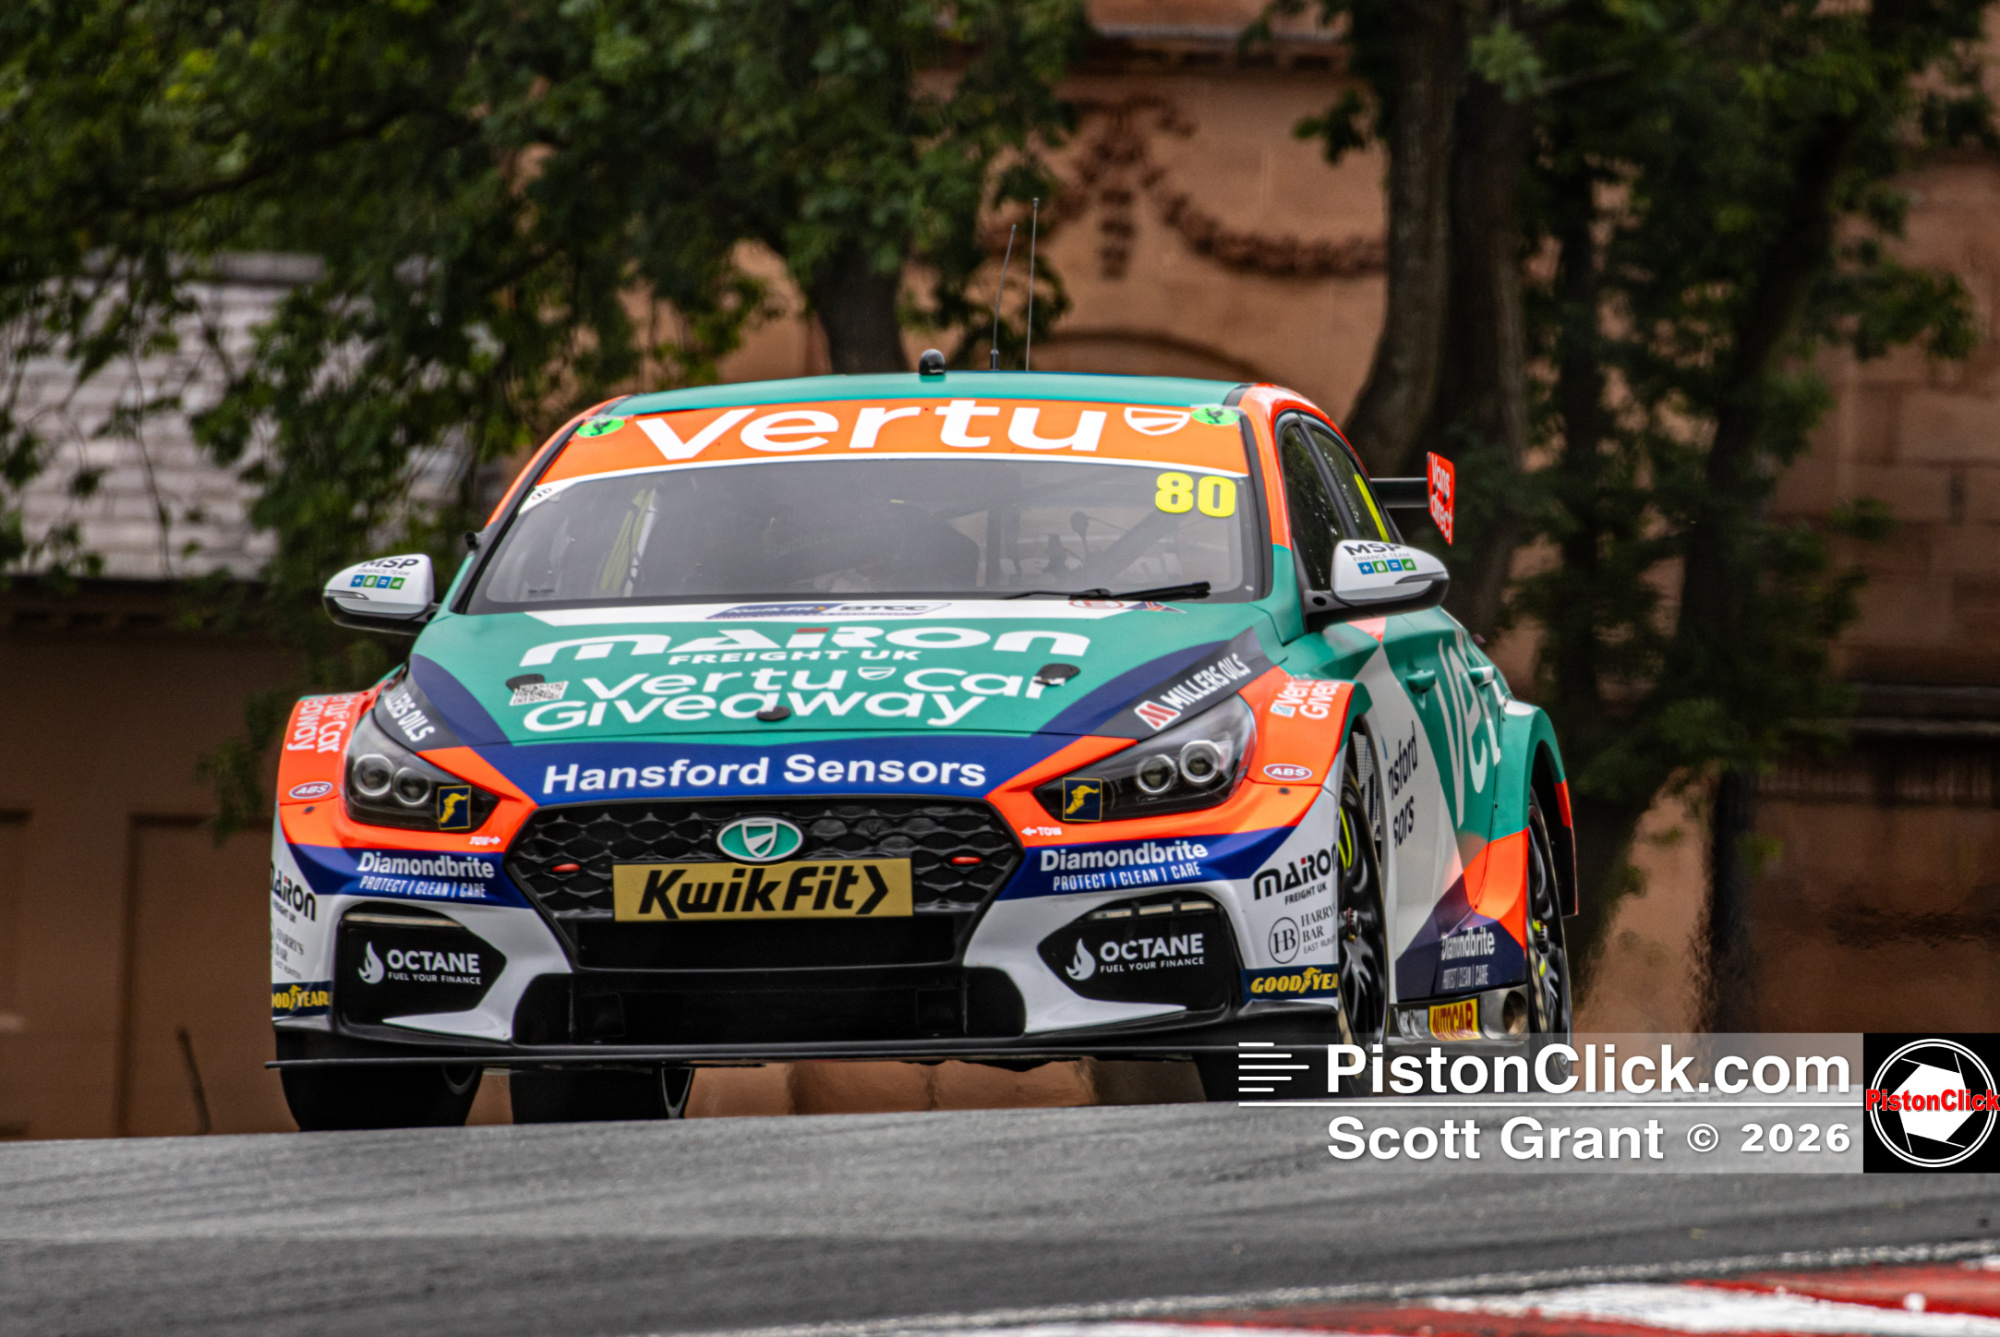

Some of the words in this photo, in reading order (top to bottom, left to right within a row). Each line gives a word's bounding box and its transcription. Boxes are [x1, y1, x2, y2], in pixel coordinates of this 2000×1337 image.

[635, 400, 1107, 461] Vertu
[1155, 471, 1237, 518] 80
[668, 650, 849, 666] FREIGHT
[858, 650, 922, 662] UK
[582, 667, 848, 700] Vertu
[903, 663, 1067, 699] Car
[1160, 665, 1230, 710] MILLERS
[1217, 653, 1251, 680] OILS
[398, 709, 435, 742] OILS
[523, 690, 988, 732] Giveaway
[317, 720, 348, 754] Car
[543, 756, 769, 795] Hansford
[783, 753, 987, 787] Sensors
[1273, 766, 1306, 778] ABS
[1387, 719, 1418, 801] nsford
[295, 784, 329, 795] ABS
[1037, 826, 1062, 836] TOW
[1393, 795, 1415, 849] sors
[356, 852, 495, 879] Diamondbrite
[1040, 841, 1209, 871] Diamondbrite
[359, 875, 408, 893] PROTECT
[415, 880, 450, 897] CLEAN
[460, 883, 487, 898] CARE
[1053, 872, 1108, 891] PROTECT
[1121, 868, 1159, 886] CLEAN
[1171, 860, 1202, 879] CARE
[1284, 885, 1316, 905] FREIGHT
[1316, 881, 1327, 893] UK
[1100, 933, 1204, 962] OCTANE
[1302, 925, 1324, 943] BAR
[1303, 940, 1319, 954] EAST
[386, 949, 481, 974] OCTANE
[1100, 965, 1124, 973] FUEL
[1128, 961, 1157, 971] YOUR
[1160, 957, 1205, 968] FINANCE
[387, 971, 410, 981] FUEL
[412, 973, 438, 983] YOUR
[440, 974, 482, 985] FINANCE
[1250, 969, 1338, 994] GOODYEA
[1431, 1002, 1476, 1035] AUTOCAR
